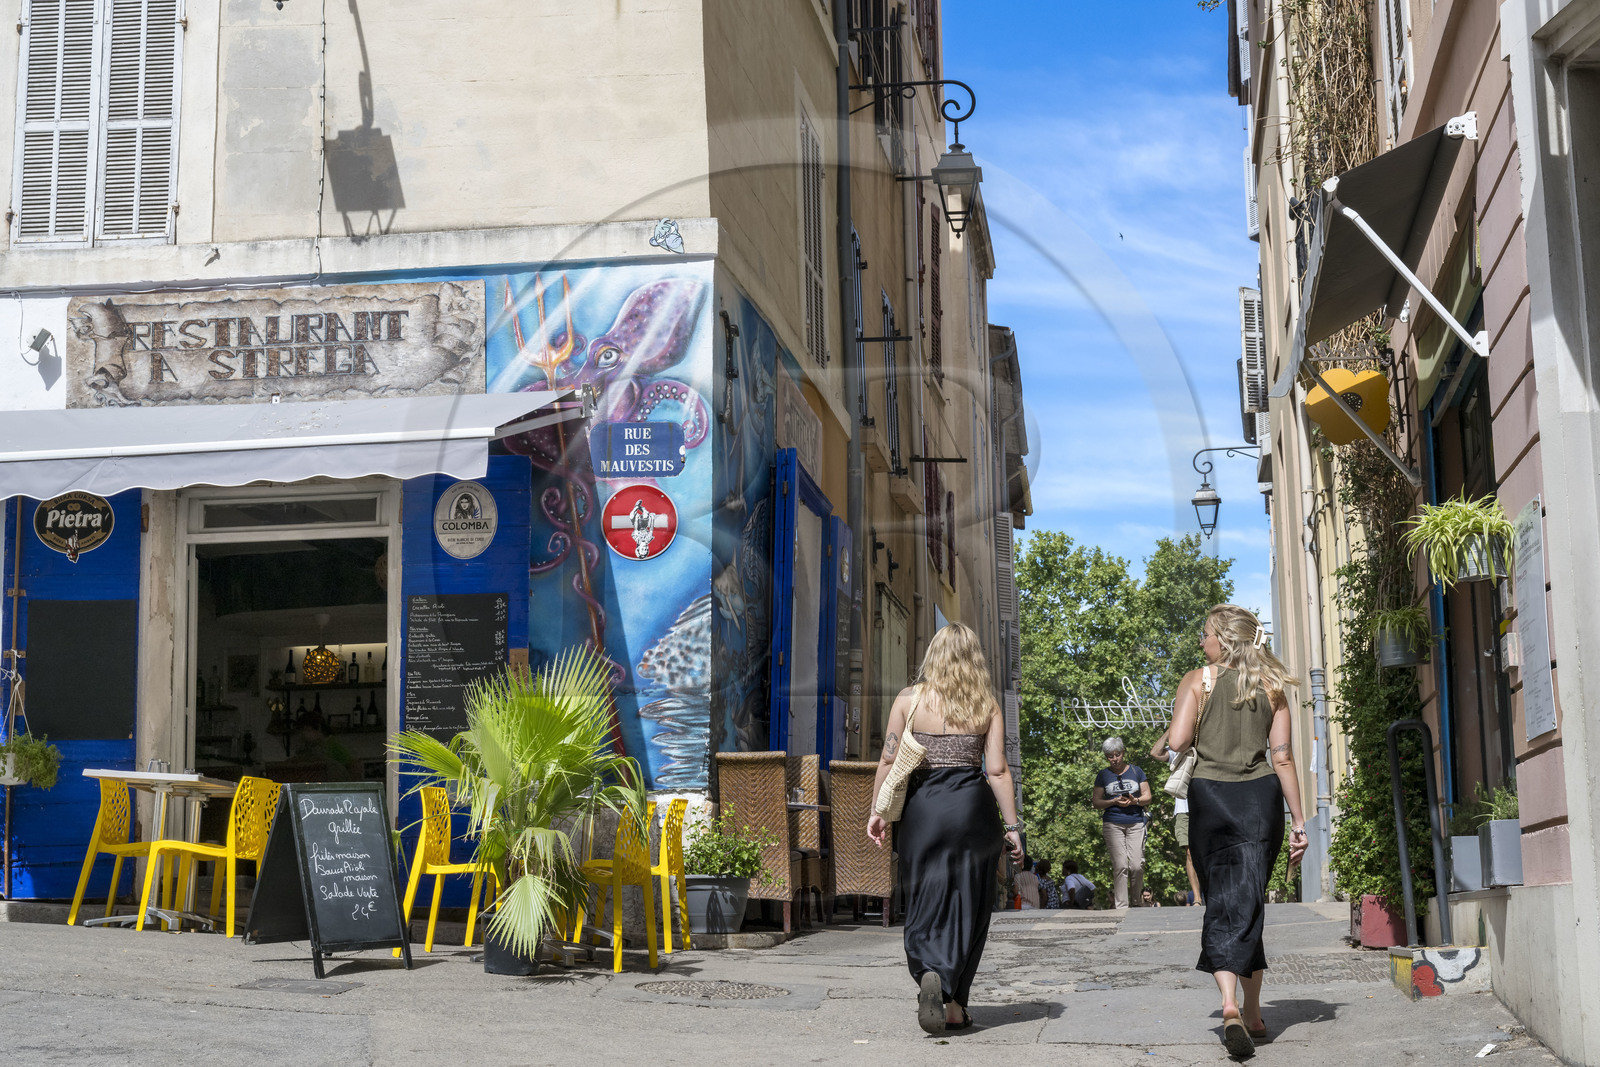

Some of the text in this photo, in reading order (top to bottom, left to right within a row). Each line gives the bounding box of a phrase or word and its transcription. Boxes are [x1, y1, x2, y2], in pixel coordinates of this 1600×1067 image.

[126, 310, 409, 350] RESTAURANT
[150, 344, 380, 382] A STREGA
[624, 428, 651, 440] RUE
[625, 444, 650, 456] DES
[600, 459, 674, 472] MAUVESTIS
[74, 493, 95, 505] CORSA
[46, 509, 103, 528] Pietra
[442, 521, 489, 531] COLOMBA
[300, 798, 344, 820] Daurade
[335, 846, 370, 860] maison
[317, 864, 343, 876] Sauce
[343, 874, 378, 882] maison
[320, 882, 354, 900] Salade
